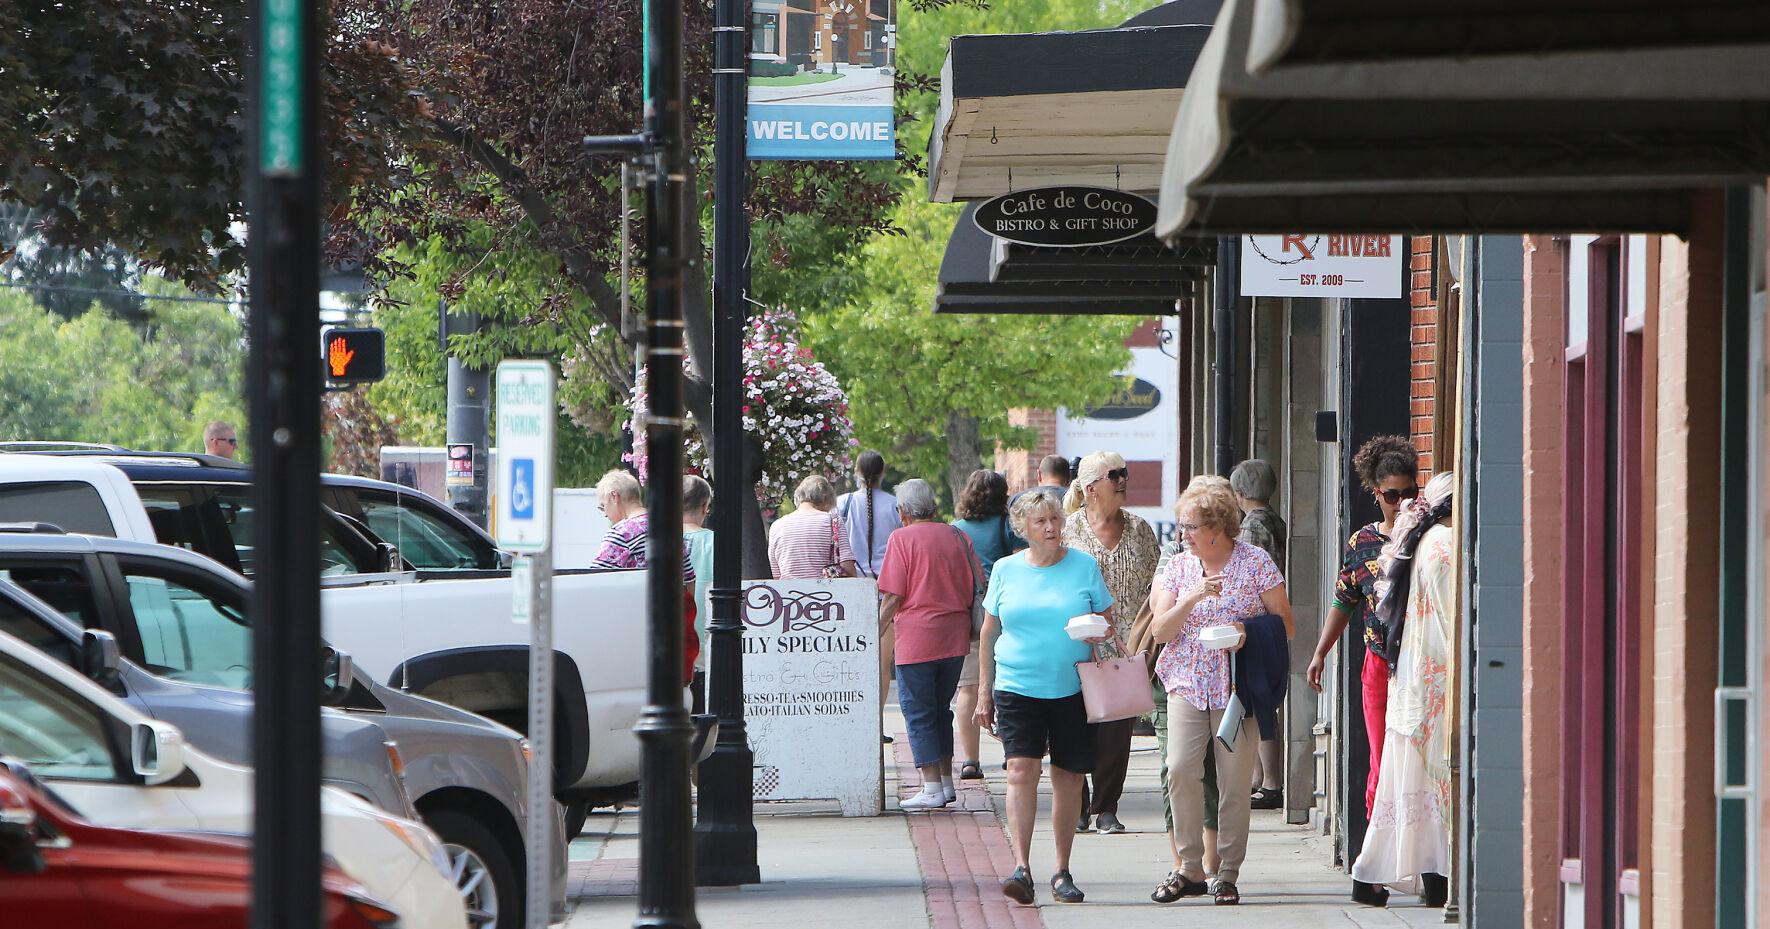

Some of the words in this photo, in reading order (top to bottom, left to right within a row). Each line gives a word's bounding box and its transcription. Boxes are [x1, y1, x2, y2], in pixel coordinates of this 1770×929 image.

[752, 120, 889, 141] WELCOME
[1000, 193, 1046, 216] Cafe
[1054, 190, 1075, 209] de
[1083, 192, 1133, 215] Coco
[996, 218, 1045, 231] BISTRO
[1050, 219, 1060, 230] &
[1065, 218, 1098, 230] GIFT
[1102, 218, 1138, 230] SHOP
[1327, 233, 1392, 257] RIVER
[1300, 274, 1319, 286] EST.
[1322, 274, 1343, 286] 2009
[500, 384, 543, 405] RESERVED
[503, 415, 540, 436] PARKING
[741, 585, 846, 634] Open
[742, 636, 771, 654] ILY
[777, 634, 867, 654] SPECIALS
[743, 669, 774, 683] stro
[813, 660, 861, 685] Gifts
[814, 703, 850, 716] SODAS
